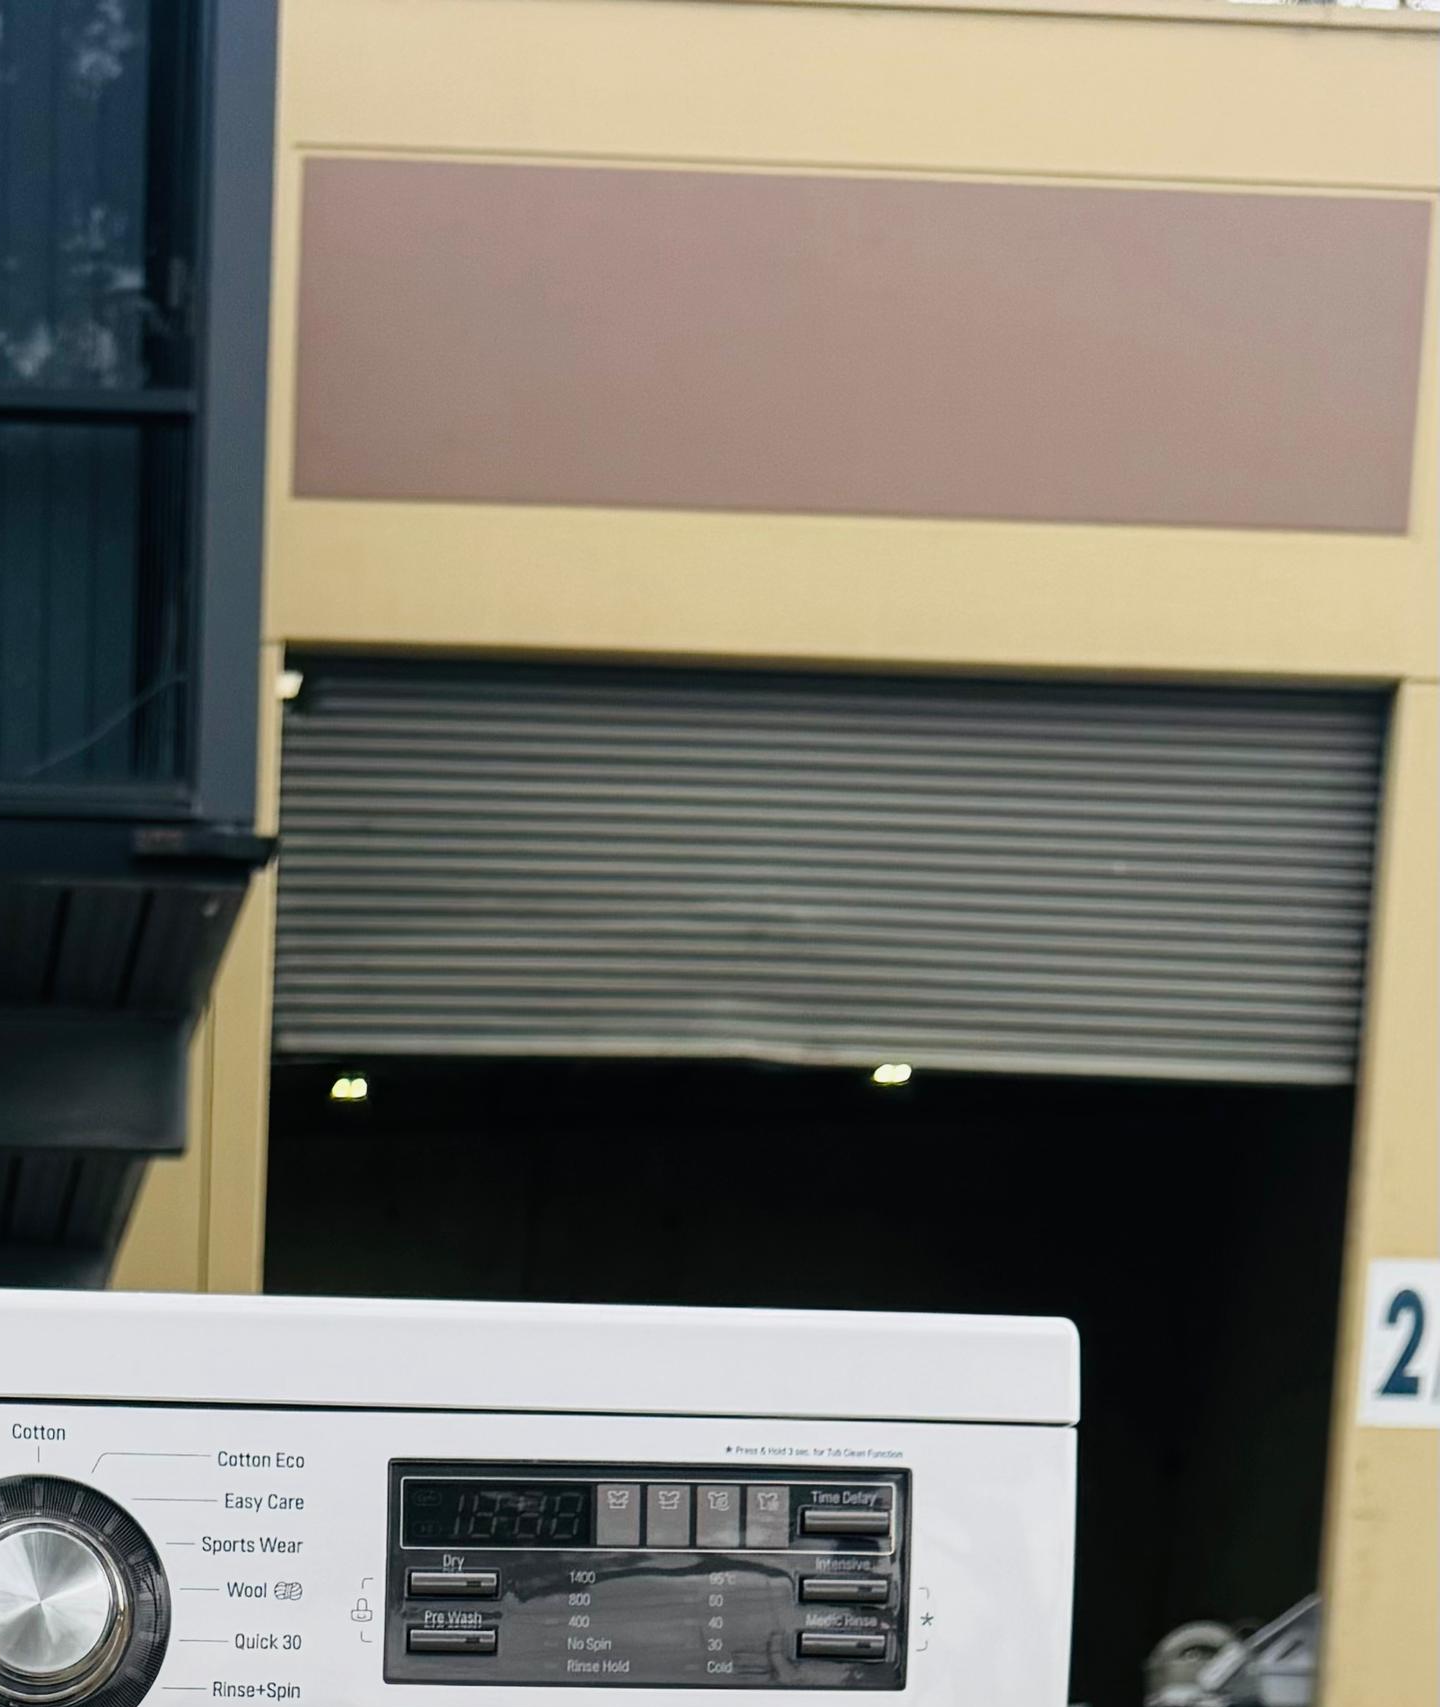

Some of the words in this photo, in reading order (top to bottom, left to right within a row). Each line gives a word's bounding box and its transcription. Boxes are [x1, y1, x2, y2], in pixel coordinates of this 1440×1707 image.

[1381, 1289, 1440, 1401] 2
[12, 1424, 65, 1441] Cotton
[217, 1452, 271, 1468] Cotton
[275, 1453, 305, 1468] Eco
[224, 1494, 263, 1513] Easy
[268, 1494, 304, 1510] Care
[810, 1491, 840, 1504] Time
[842, 1491, 879, 1506] Delay
[202, 1537, 254, 1555] Sports
[259, 1537, 303, 1553] Wear
[443, 1554, 465, 1571] Dry
[816, 1557, 871, 1570] Intensive
[570, 1571, 596, 1584] 1400
[227, 1582, 267, 1598] Wool
[569, 1593, 590, 1606] 800
[424, 1611, 444, 1624] Pre
[448, 1611, 482, 1624] Wash
[569, 1616, 590, 1628] 400
[708, 1617, 723, 1629] 40
[806, 1614, 841, 1626] Medic
[235, 1633, 277, 1650] Quick
[282, 1634, 302, 1650] 30
[568, 1638, 584, 1650] No
[586, 1638, 611, 1652] Spin
[708, 1639, 722, 1651] 30
[567, 1660, 599, 1673] Rinse
[602, 1661, 630, 1673] Hold
[707, 1662, 732, 1673] Cold
[213, 1682, 301, 1701] Rinse+Spin
